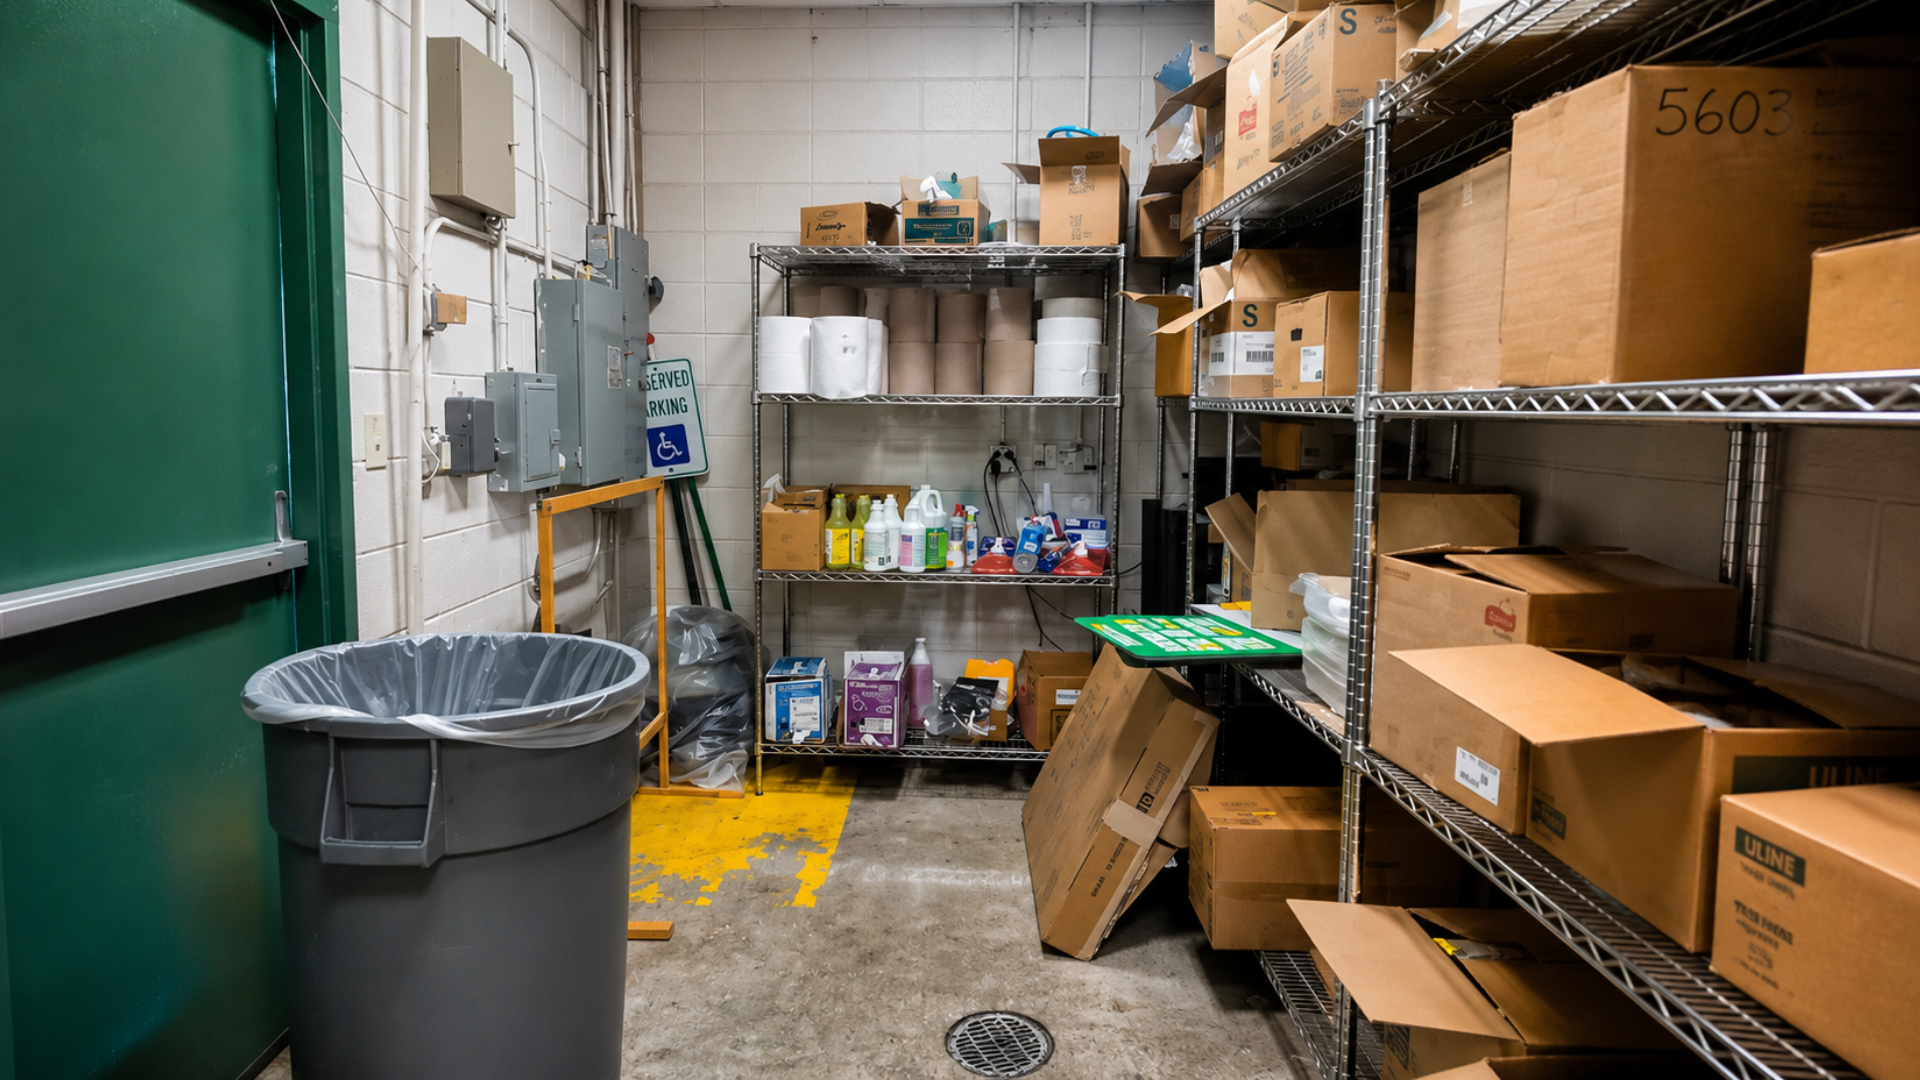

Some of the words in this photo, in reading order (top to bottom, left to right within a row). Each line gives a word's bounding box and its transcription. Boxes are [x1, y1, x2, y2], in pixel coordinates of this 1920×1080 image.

[1339, 8, 1358, 35] S
[1655, 87, 1794, 136] 5603
[1242, 303, 1259, 328] S
[1744, 834, 1797, 878] ULINE
